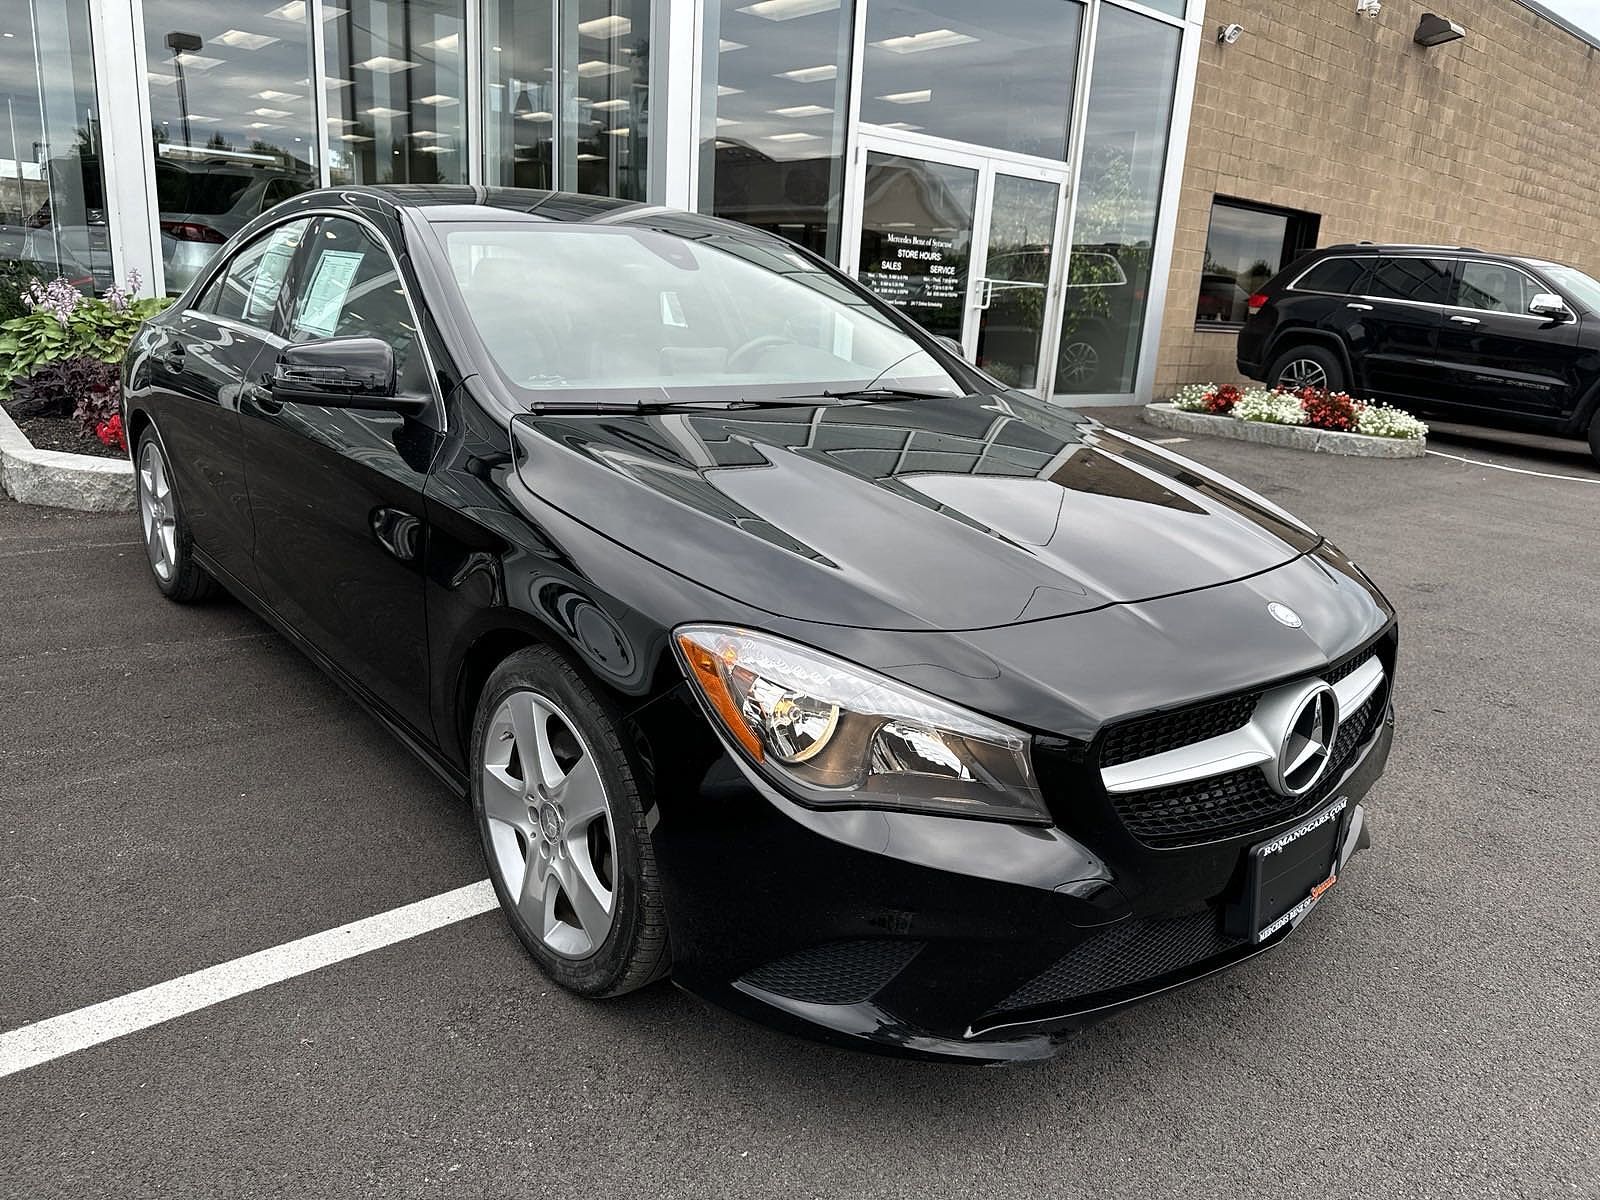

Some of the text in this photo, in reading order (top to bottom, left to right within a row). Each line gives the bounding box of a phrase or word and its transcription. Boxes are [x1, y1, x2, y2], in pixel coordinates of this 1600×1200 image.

[887, 233, 912, 244] Mercedes
[897, 249, 918, 260] STORE
[881, 260, 902, 271] SALES
[929, 265, 956, 275] SERVICE
[1263, 799, 1348, 857] ROMANOCARS.COM
